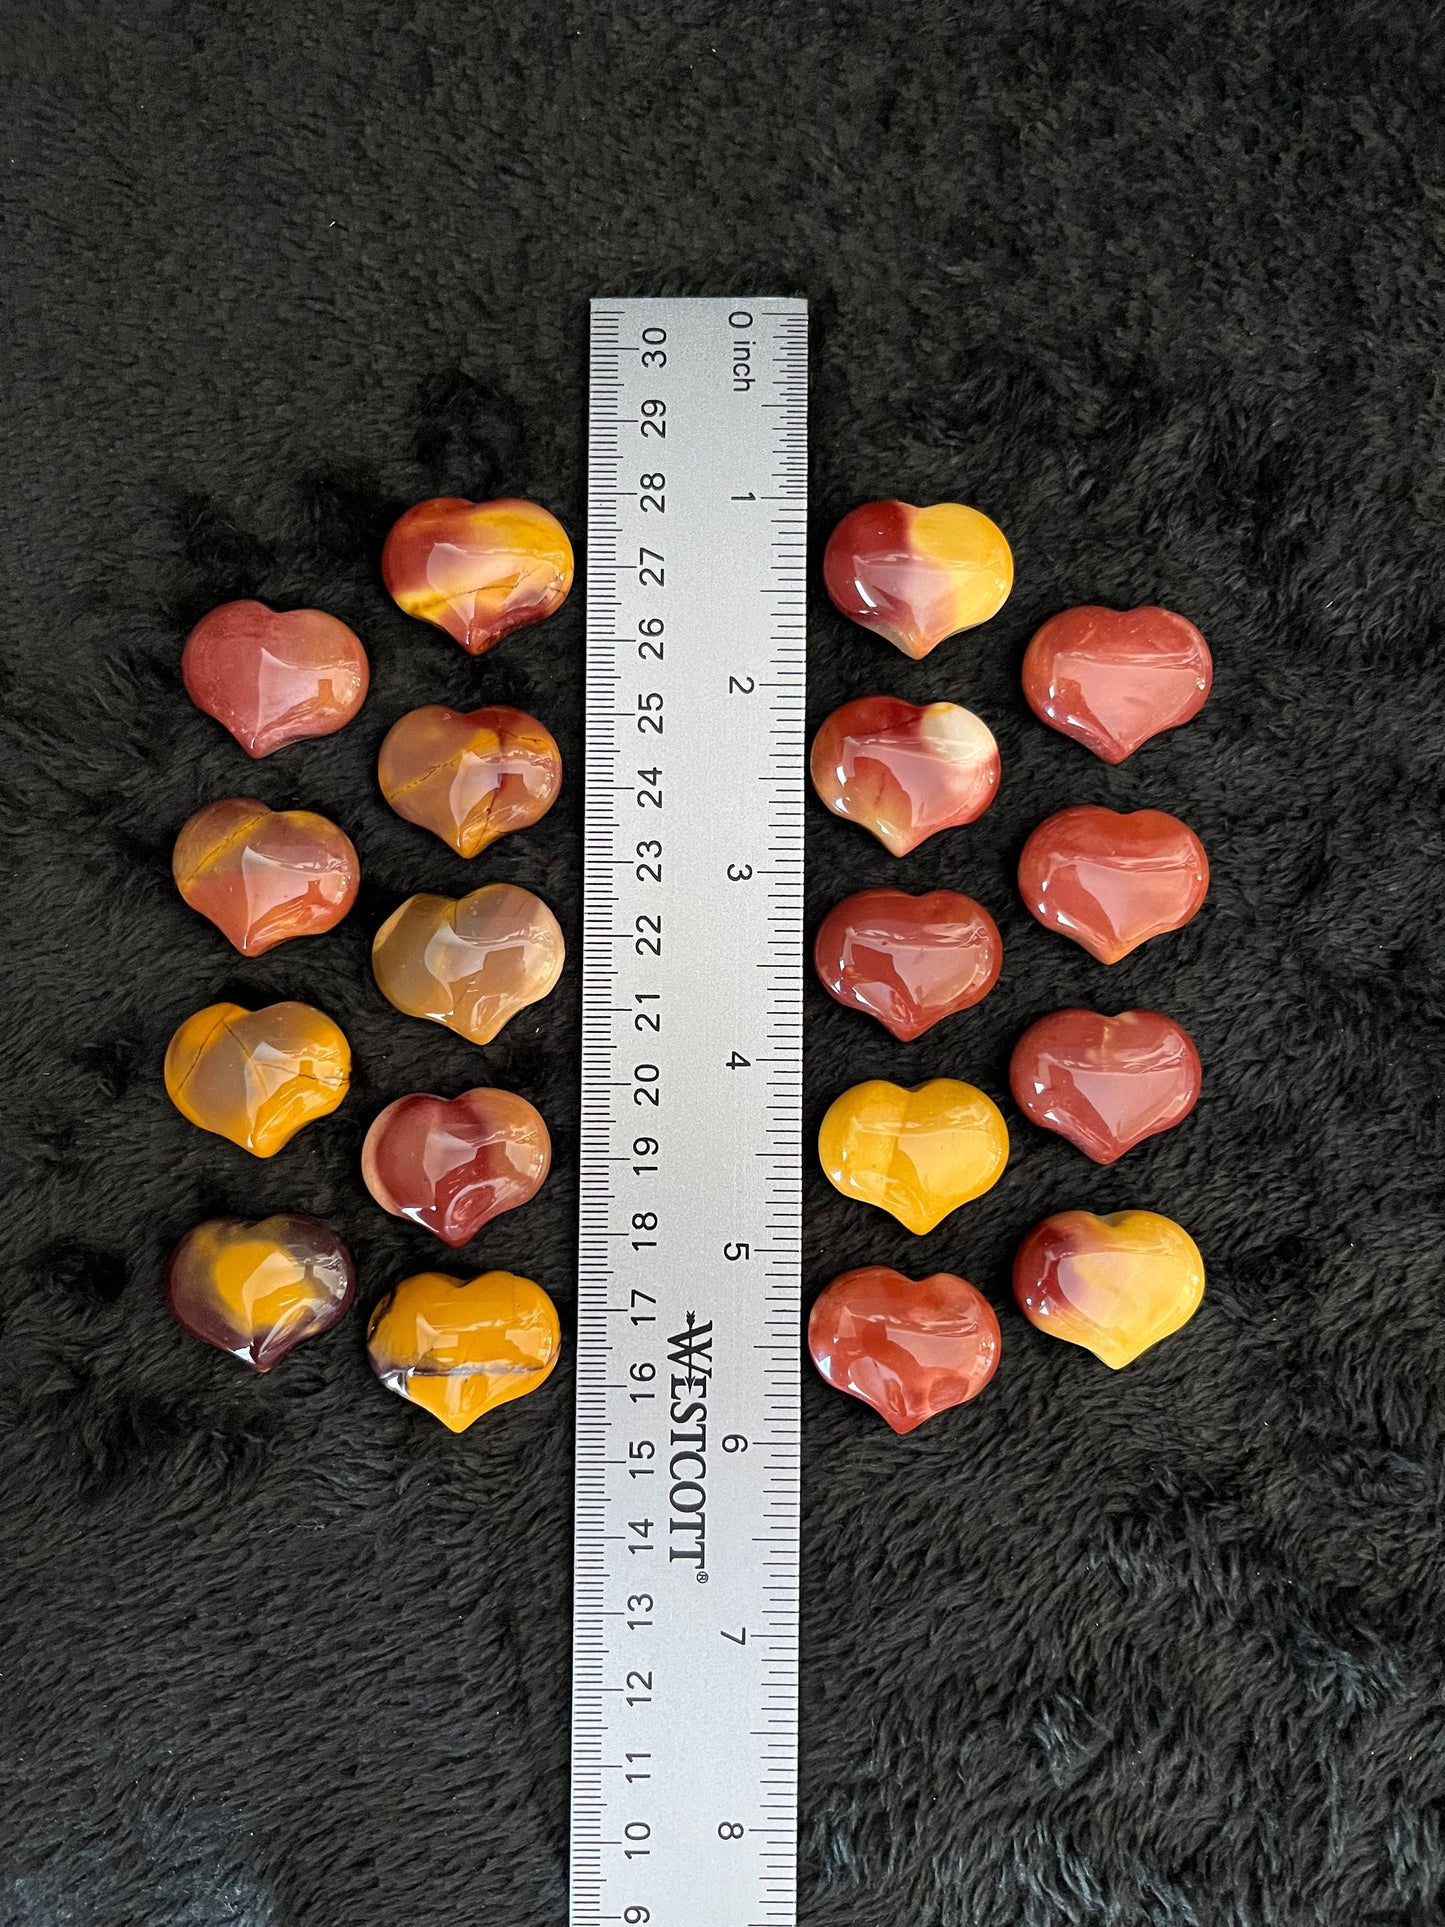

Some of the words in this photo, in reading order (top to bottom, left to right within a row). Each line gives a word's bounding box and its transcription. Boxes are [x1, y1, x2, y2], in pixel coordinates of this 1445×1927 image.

[728, 310, 754, 329] 0
[641, 328, 667, 369] 30
[732, 341, 756, 392] inch
[641, 399, 666, 439] 29
[640, 472, 666, 514] 28
[639, 547, 665, 587] 27
[639, 618, 665, 661] 26
[729, 675, 755, 695] 2
[638, 692, 664, 735] 25
[637, 766, 663, 809] 24
[636, 840, 662, 883] 23
[727, 863, 753, 882] 3
[635, 915, 662, 957] 22
[634, 994, 661, 1033] 21
[726, 1051, 751, 1071] 4
[634, 1063, 660, 1107] 20
[633, 1136, 659, 1176] 19
[632, 1211, 658, 1252] 18
[723, 1242, 750, 1262] 5
[630, 1289, 657, 1327] 17
[629, 1362, 656, 1404] 16
[628, 1440, 656, 1479] 15
[721, 1434, 749, 1454] 6
[628, 1518, 654, 1555] 14
[626, 1593, 654, 1631] 13
[720, 1627, 746, 1646] 7
[626, 1671, 653, 1707] 12
[625, 1753, 652, 1784] 11
[624, 1822, 651, 1860] 10
[717, 1821, 744, 1841] 8
[623, 1905, 651, 1925] 9
